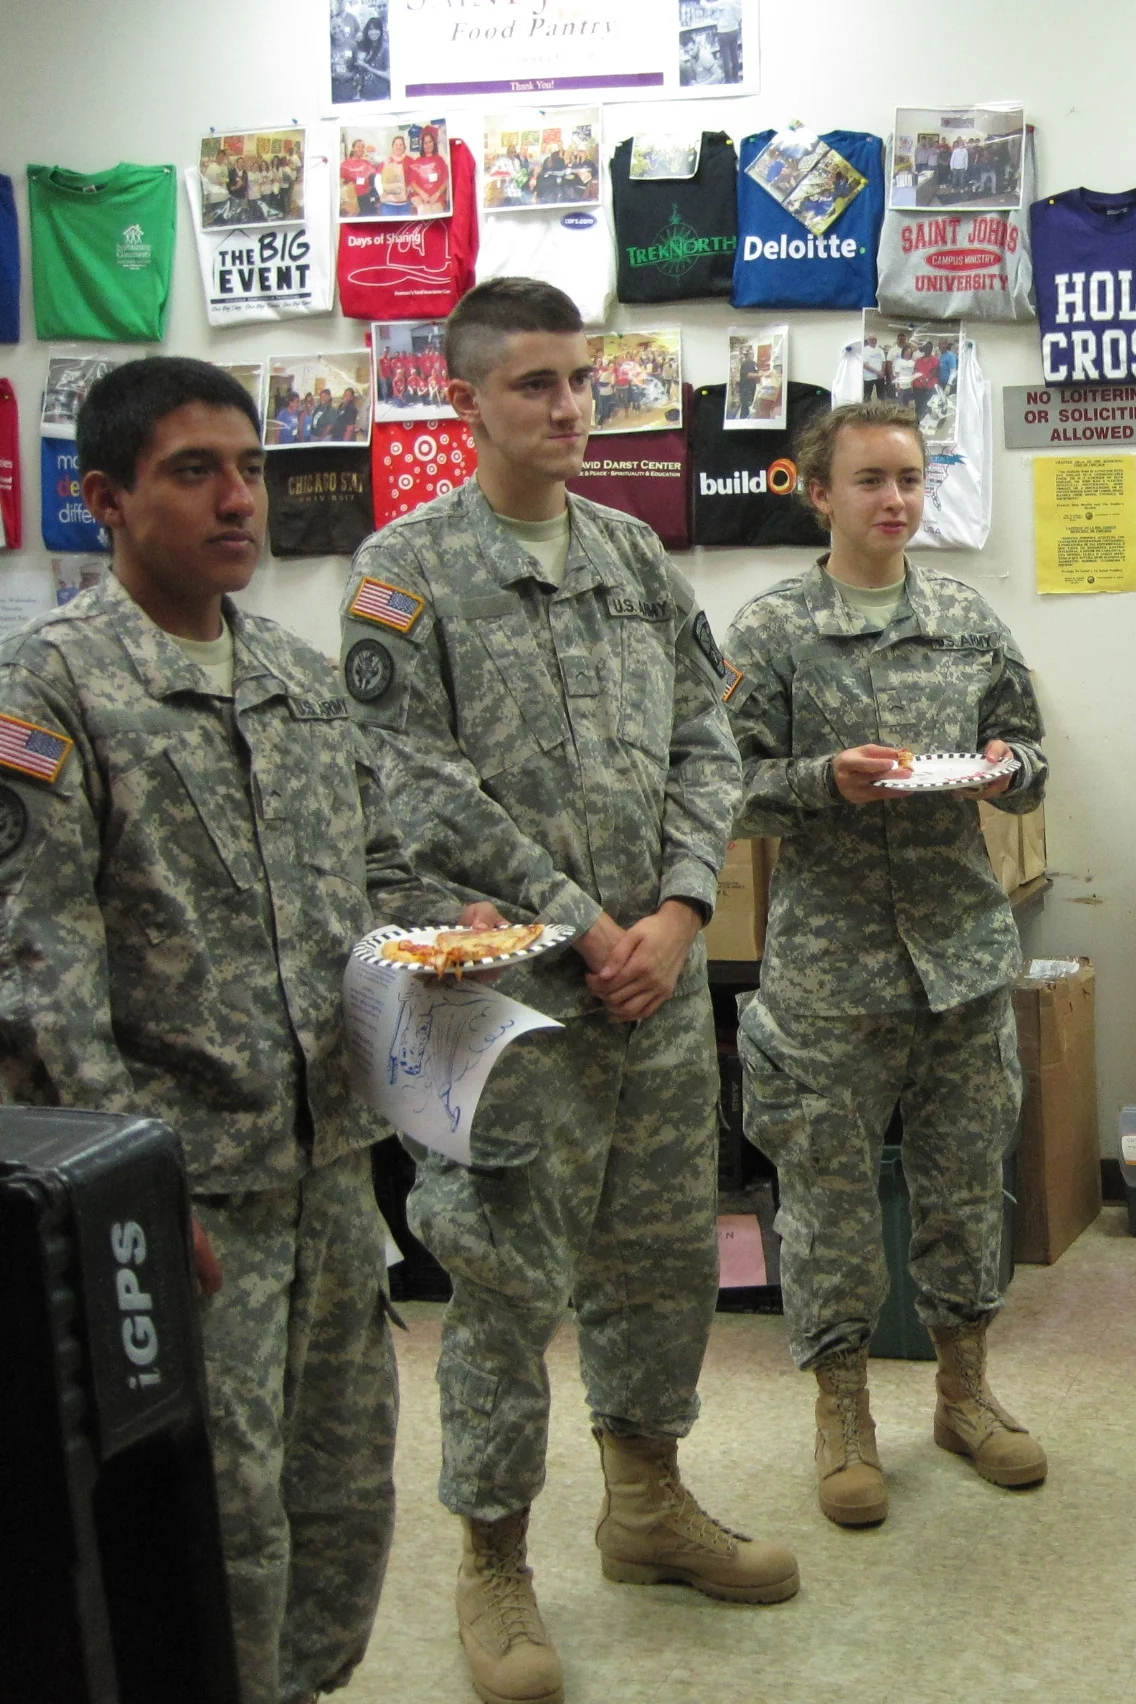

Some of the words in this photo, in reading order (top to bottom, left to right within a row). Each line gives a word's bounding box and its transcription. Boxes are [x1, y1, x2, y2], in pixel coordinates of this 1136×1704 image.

[451, 20, 516, 41] Food
[528, 18, 617, 40] Pantry
[510, 81, 535, 91] Thank
[536, 80, 555, 90] You!
[564, 217, 594, 225] cars.com
[348, 235, 373, 248] Days
[374, 232, 385, 244] of
[386, 232, 421, 245] Sharing
[901, 217, 963, 255] SAINT
[258, 229, 312, 263] BIG
[219, 248, 256, 267] THE
[931, 254, 963, 266] CAMPUS
[963, 252, 995, 265] MINISTRY
[219, 264, 311, 295] EVENT
[915, 274, 1009, 293] UNIVERSITY
[1026, 391, 1052, 405] NO
[1024, 410, 1049, 424] OR
[1050, 426, 1135, 442] ALLOWED
[603, 460, 638, 469] DARST
[640, 460, 682, 470] CENTER
[110, 1220, 161, 1390] iGPS
